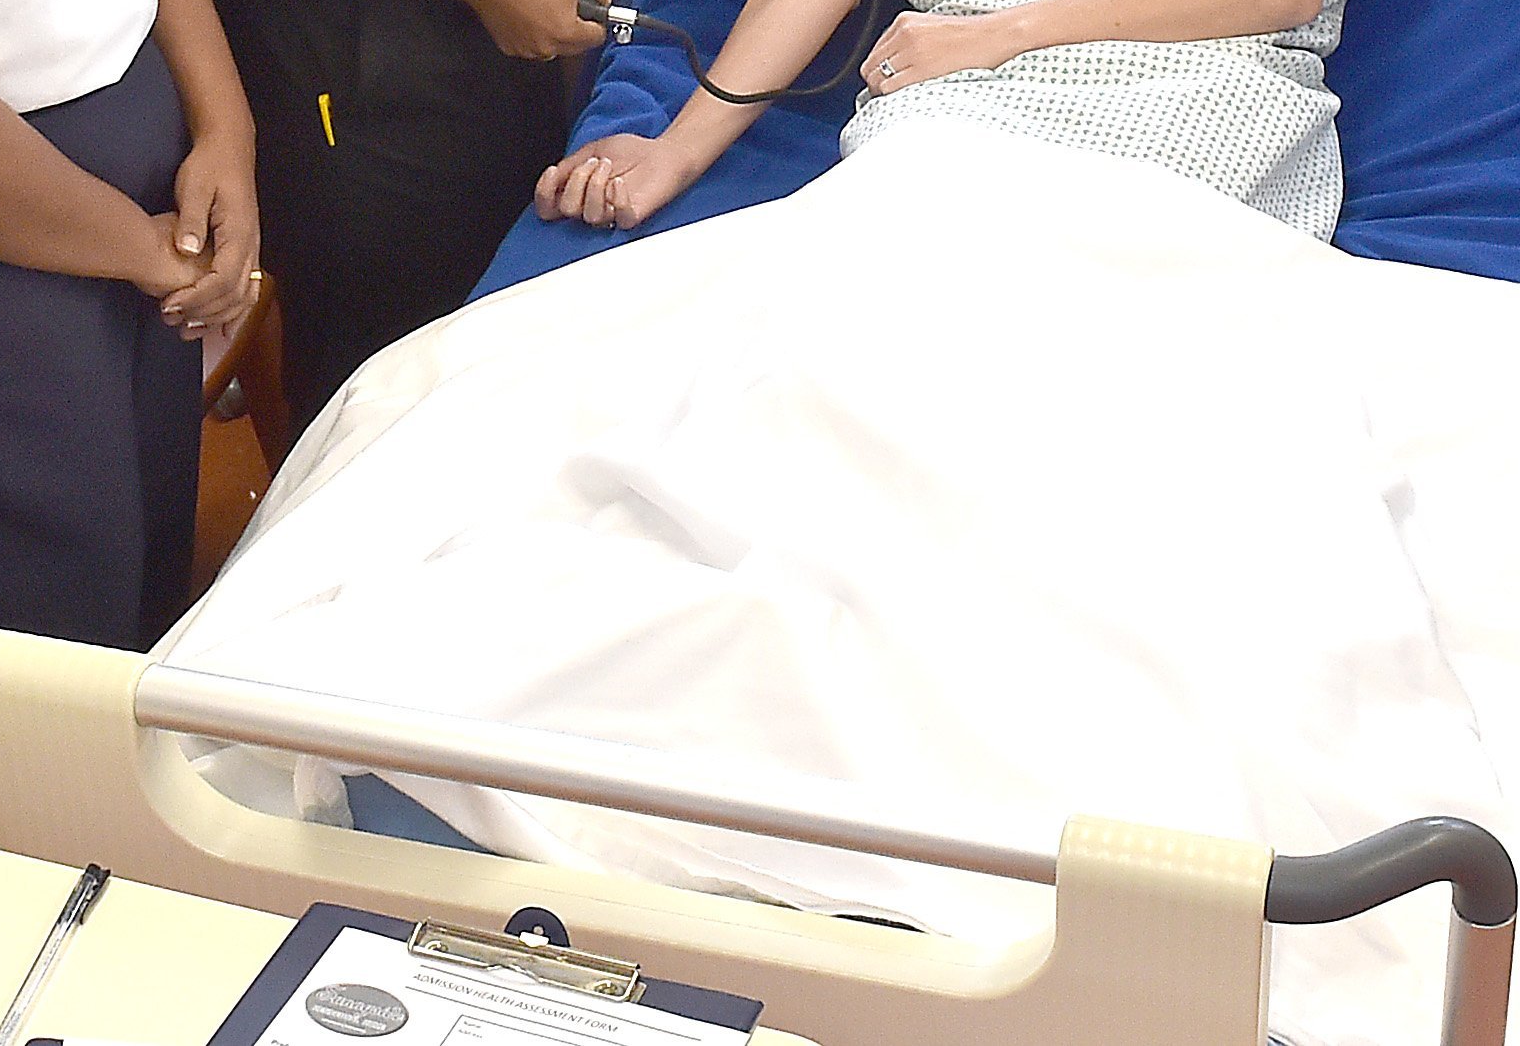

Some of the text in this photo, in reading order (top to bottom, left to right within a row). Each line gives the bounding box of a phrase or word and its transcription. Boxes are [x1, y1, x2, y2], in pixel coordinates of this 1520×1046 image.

[413, 973, 619, 1033] ADMISSION HEALTH ASSESSMENT FORM
